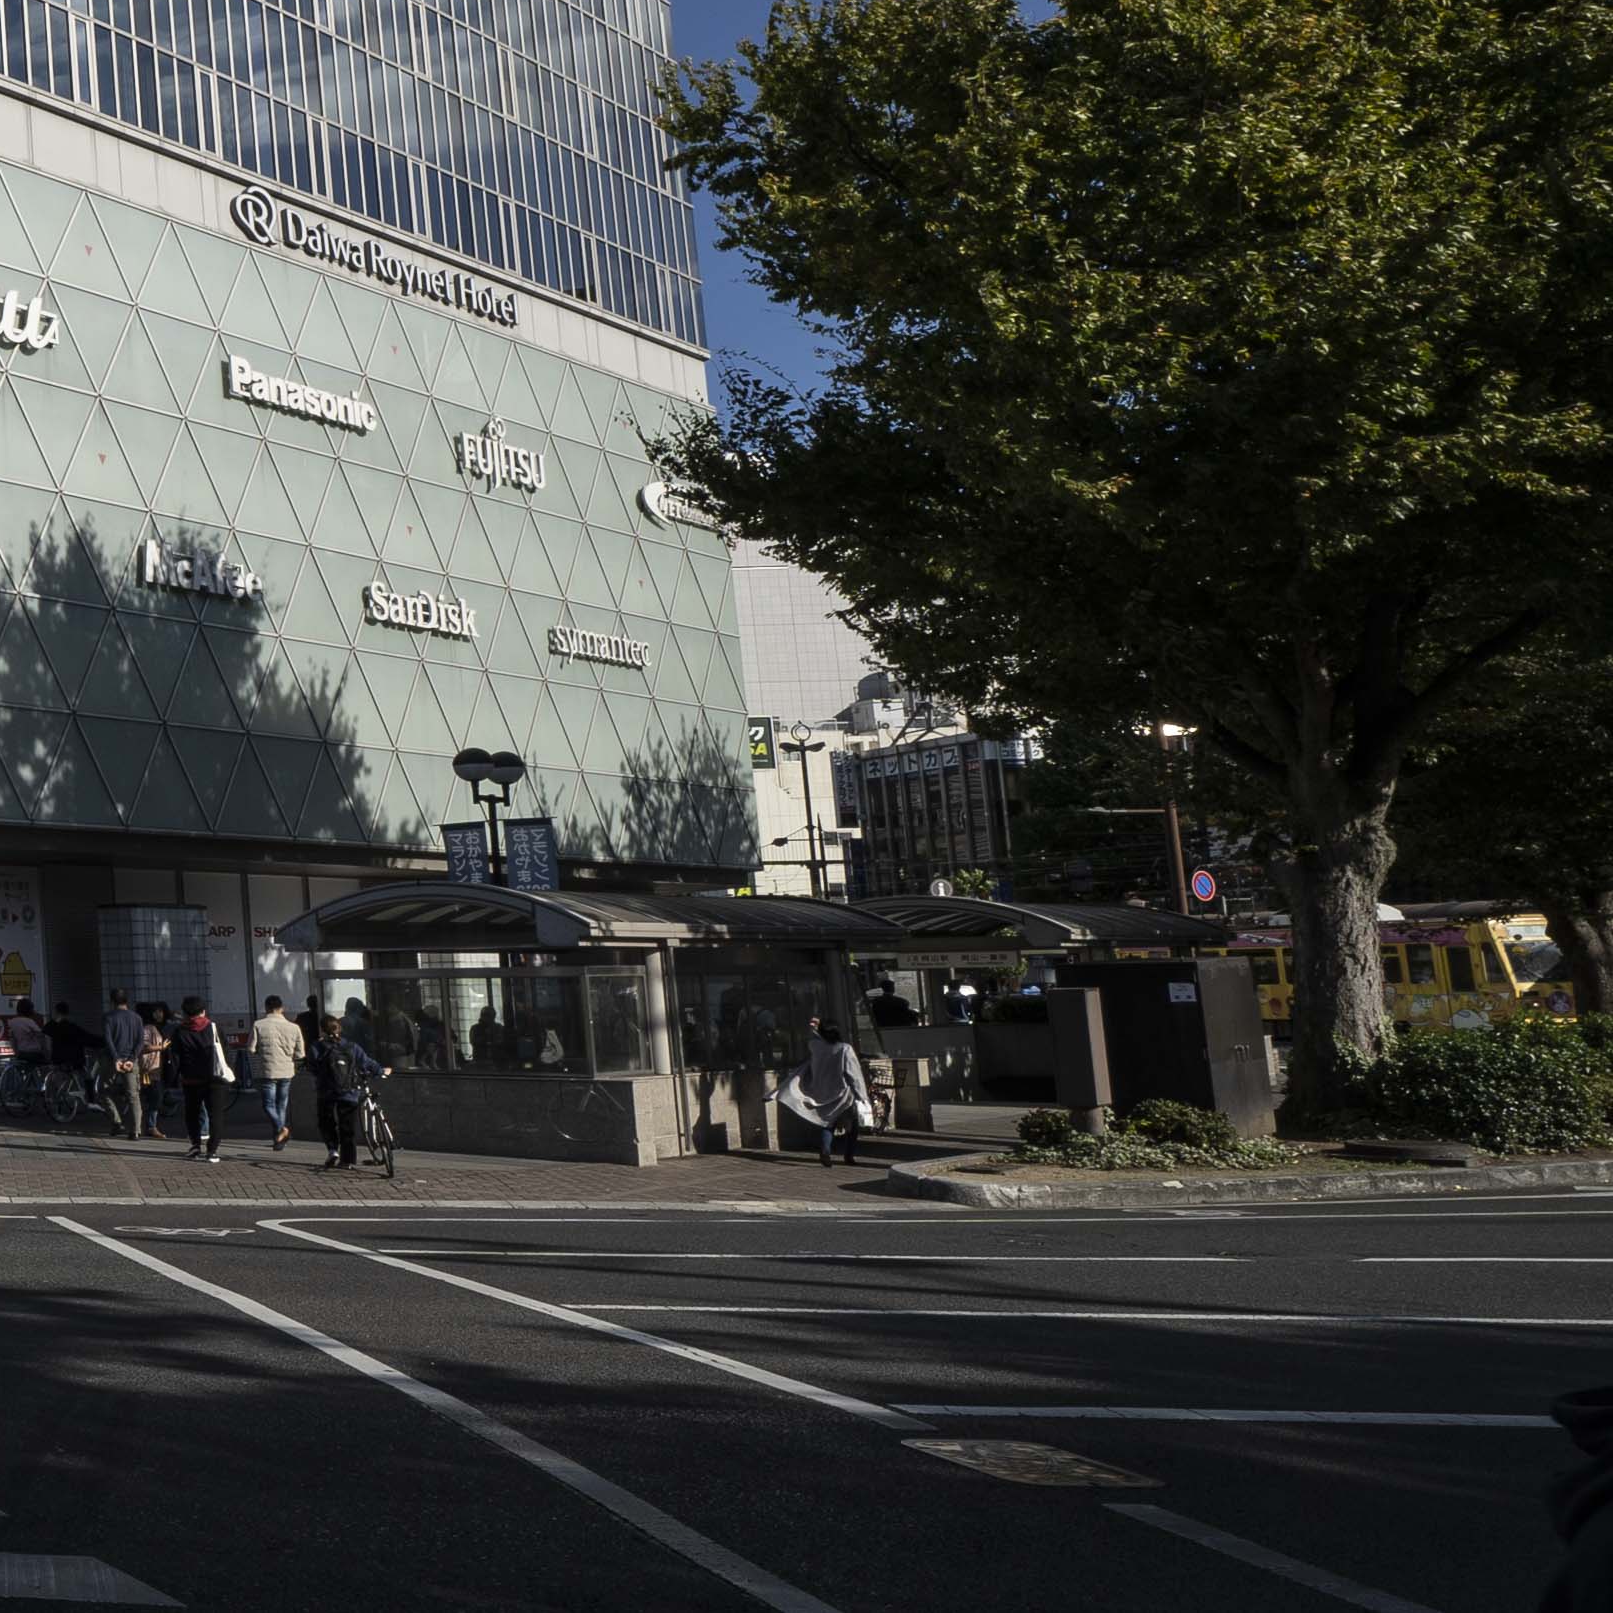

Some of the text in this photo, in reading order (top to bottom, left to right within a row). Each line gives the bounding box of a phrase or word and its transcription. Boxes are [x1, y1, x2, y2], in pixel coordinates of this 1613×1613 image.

[286, 209, 366, 270] Daiwa
[369, 241, 452, 303] Roynet
[458, 274, 519, 326] Hotel
[228, 354, 377, 433] Panasonic
[461, 426, 546, 490] FUJITSU
[145, 538, 265, 601] McAfee
[370, 580, 480, 639] SanDisk
[554, 625, 652, 668] symantec
